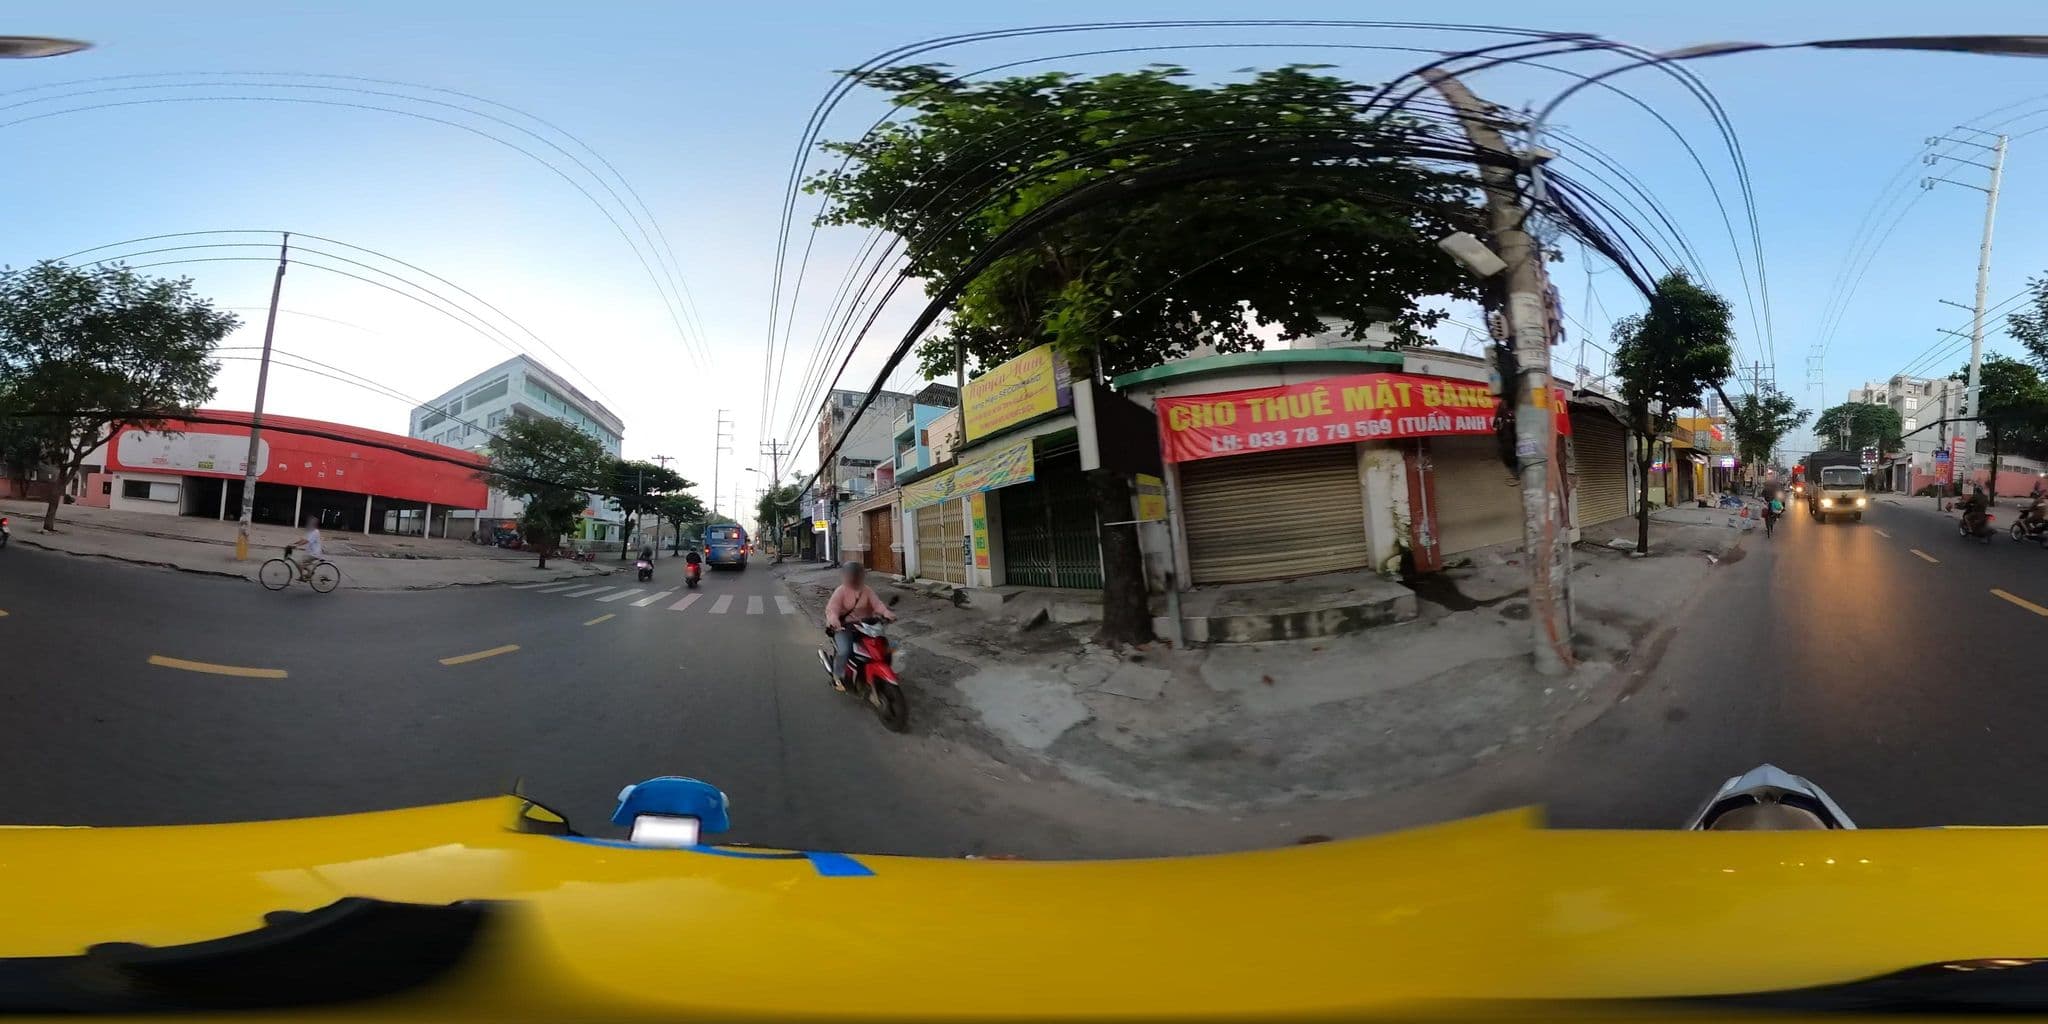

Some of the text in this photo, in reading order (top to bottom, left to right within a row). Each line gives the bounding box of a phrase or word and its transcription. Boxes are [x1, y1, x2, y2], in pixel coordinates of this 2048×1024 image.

[1169, 401, 1236, 432] CHO
[1245, 386, 1333, 423] THUÊ
[1342, 379, 1412, 414] MẶT
[1422, 380, 1494, 409] BẰNG
[1211, 434, 1243, 453] LH:
[1249, 430, 1287, 449] 033
[1293, 426, 1319, 443] 78
[1324, 423, 1350, 440] 79
[1355, 418, 1392, 437] 569
[1399, 411, 1450, 435] (TUẤN
[1456, 416, 1485, 431] ANH
